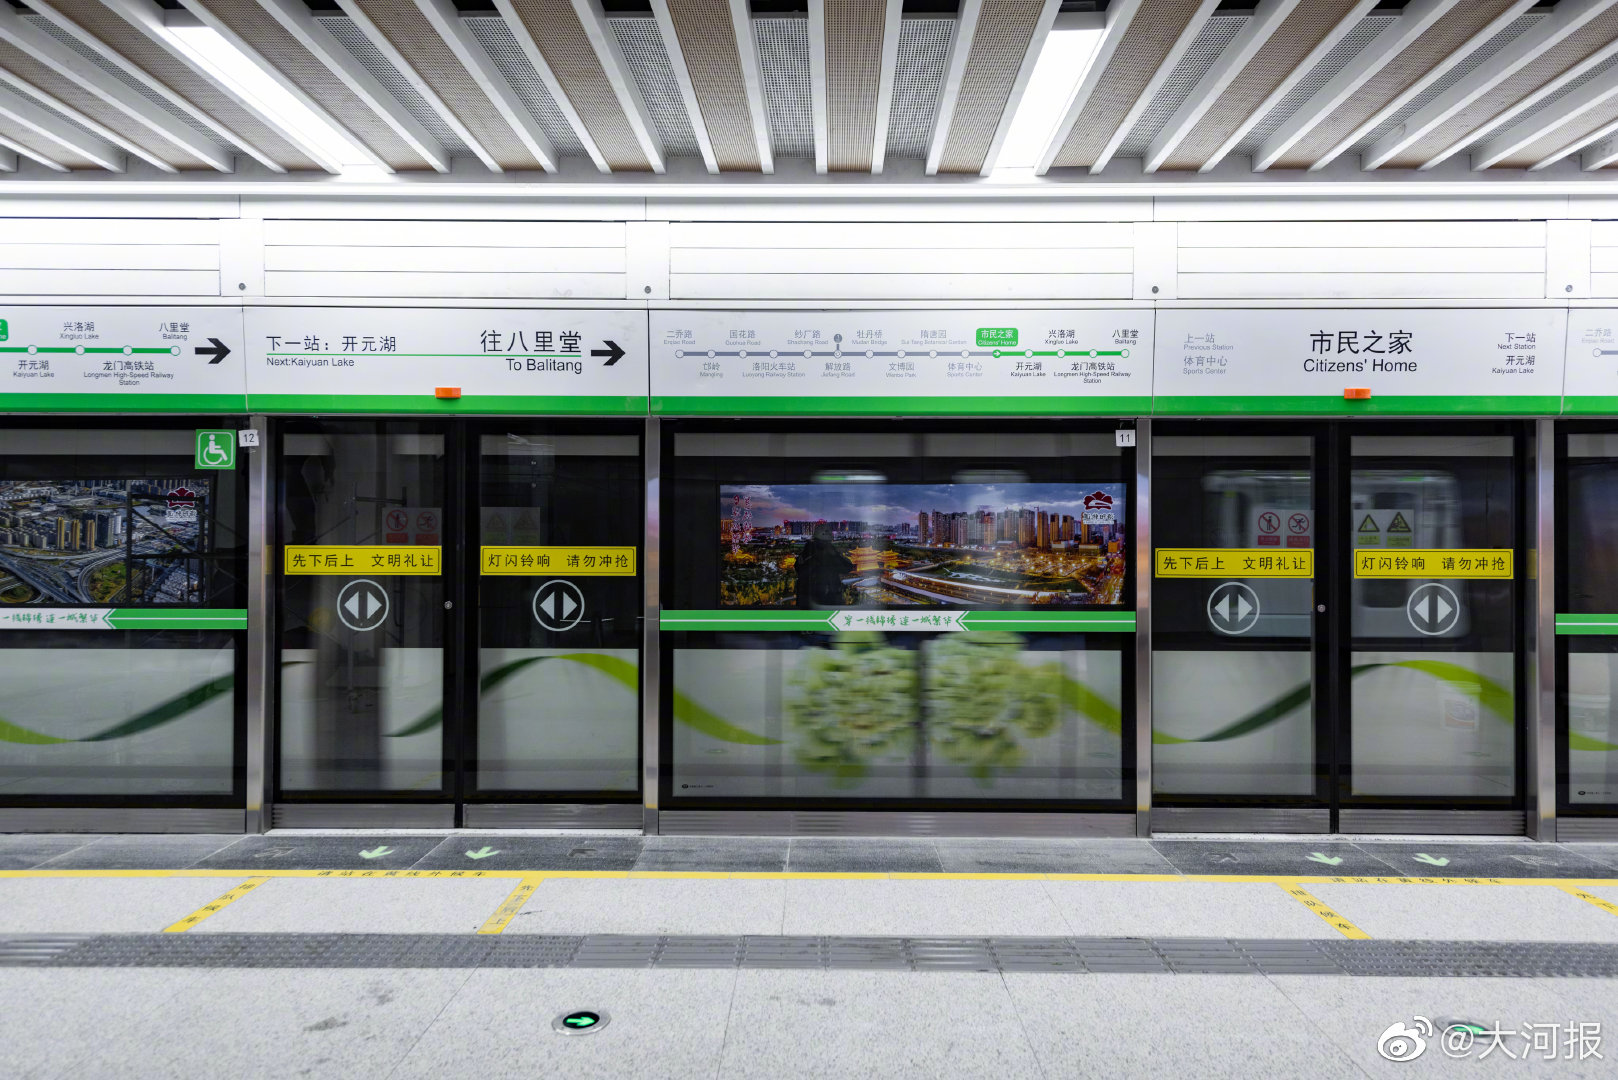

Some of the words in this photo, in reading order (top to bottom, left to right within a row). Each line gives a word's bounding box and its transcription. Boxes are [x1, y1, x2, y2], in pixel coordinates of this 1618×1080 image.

[63, 321, 95, 332] 兴洛湖
[158, 322, 190, 333] 八里堂
[162, 333, 188, 341] Balitang
[729, 329, 756, 339] 国花路
[856, 329, 883, 339] 牡丹桥
[980, 329, 1014, 339] 市民之家
[1048, 329, 1075, 339] 兴洛湖
[1112, 329, 1139, 339] 八里堂
[1183, 332, 1216, 344] 上一站
[1504, 332, 1537, 343] 下一站
[480, 329, 582, 353] 往八里堂
[1309, 329, 1413, 355] 市民之家
[18, 359, 50, 371] 开元湖
[103, 360, 155, 371] 龙门高铁站
[331, 357, 355, 367] Lake
[1183, 355, 1228, 367] 体育中心
[1303, 358, 1368, 372] Citizens'
[1372, 358, 1418, 372] Home
[1505, 355, 1536, 366] 开元湖
[505, 358, 523, 371] To
[526, 358, 583, 375] Balitang
[752, 362, 796, 371] 洛阳火车站
[824, 362, 851, 371] 解放路
[947, 361, 983, 371] 体育中心
[1015, 361, 1042, 371] 开元湖
[1071, 361, 1116, 371] 龙门高铁站
[1183, 367, 1204, 375] Sports
[13, 371, 38, 379] Kaiyuan
[83, 371, 112, 379] Longmen
[113, 371, 149, 379] High-Speed
[150, 371, 174, 379] Railway
[1491, 367, 1518, 376] Kaiyuan
[243, 433, 256, 443] 12
[1118, 433, 1131, 443] 11
[292, 553, 355, 569] 先下后上
[370, 553, 435, 569] 文明礼让
[487, 553, 551, 569] 灯闪铃响
[566, 553, 629, 569] 请勿冲抢
[1162, 556, 1226, 571] 先下后上
[1242, 556, 1307, 571] 文明礼让
[1360, 556, 1426, 572] 灯闪铃响
[1441, 556, 1506, 572] 请勿冲抢
